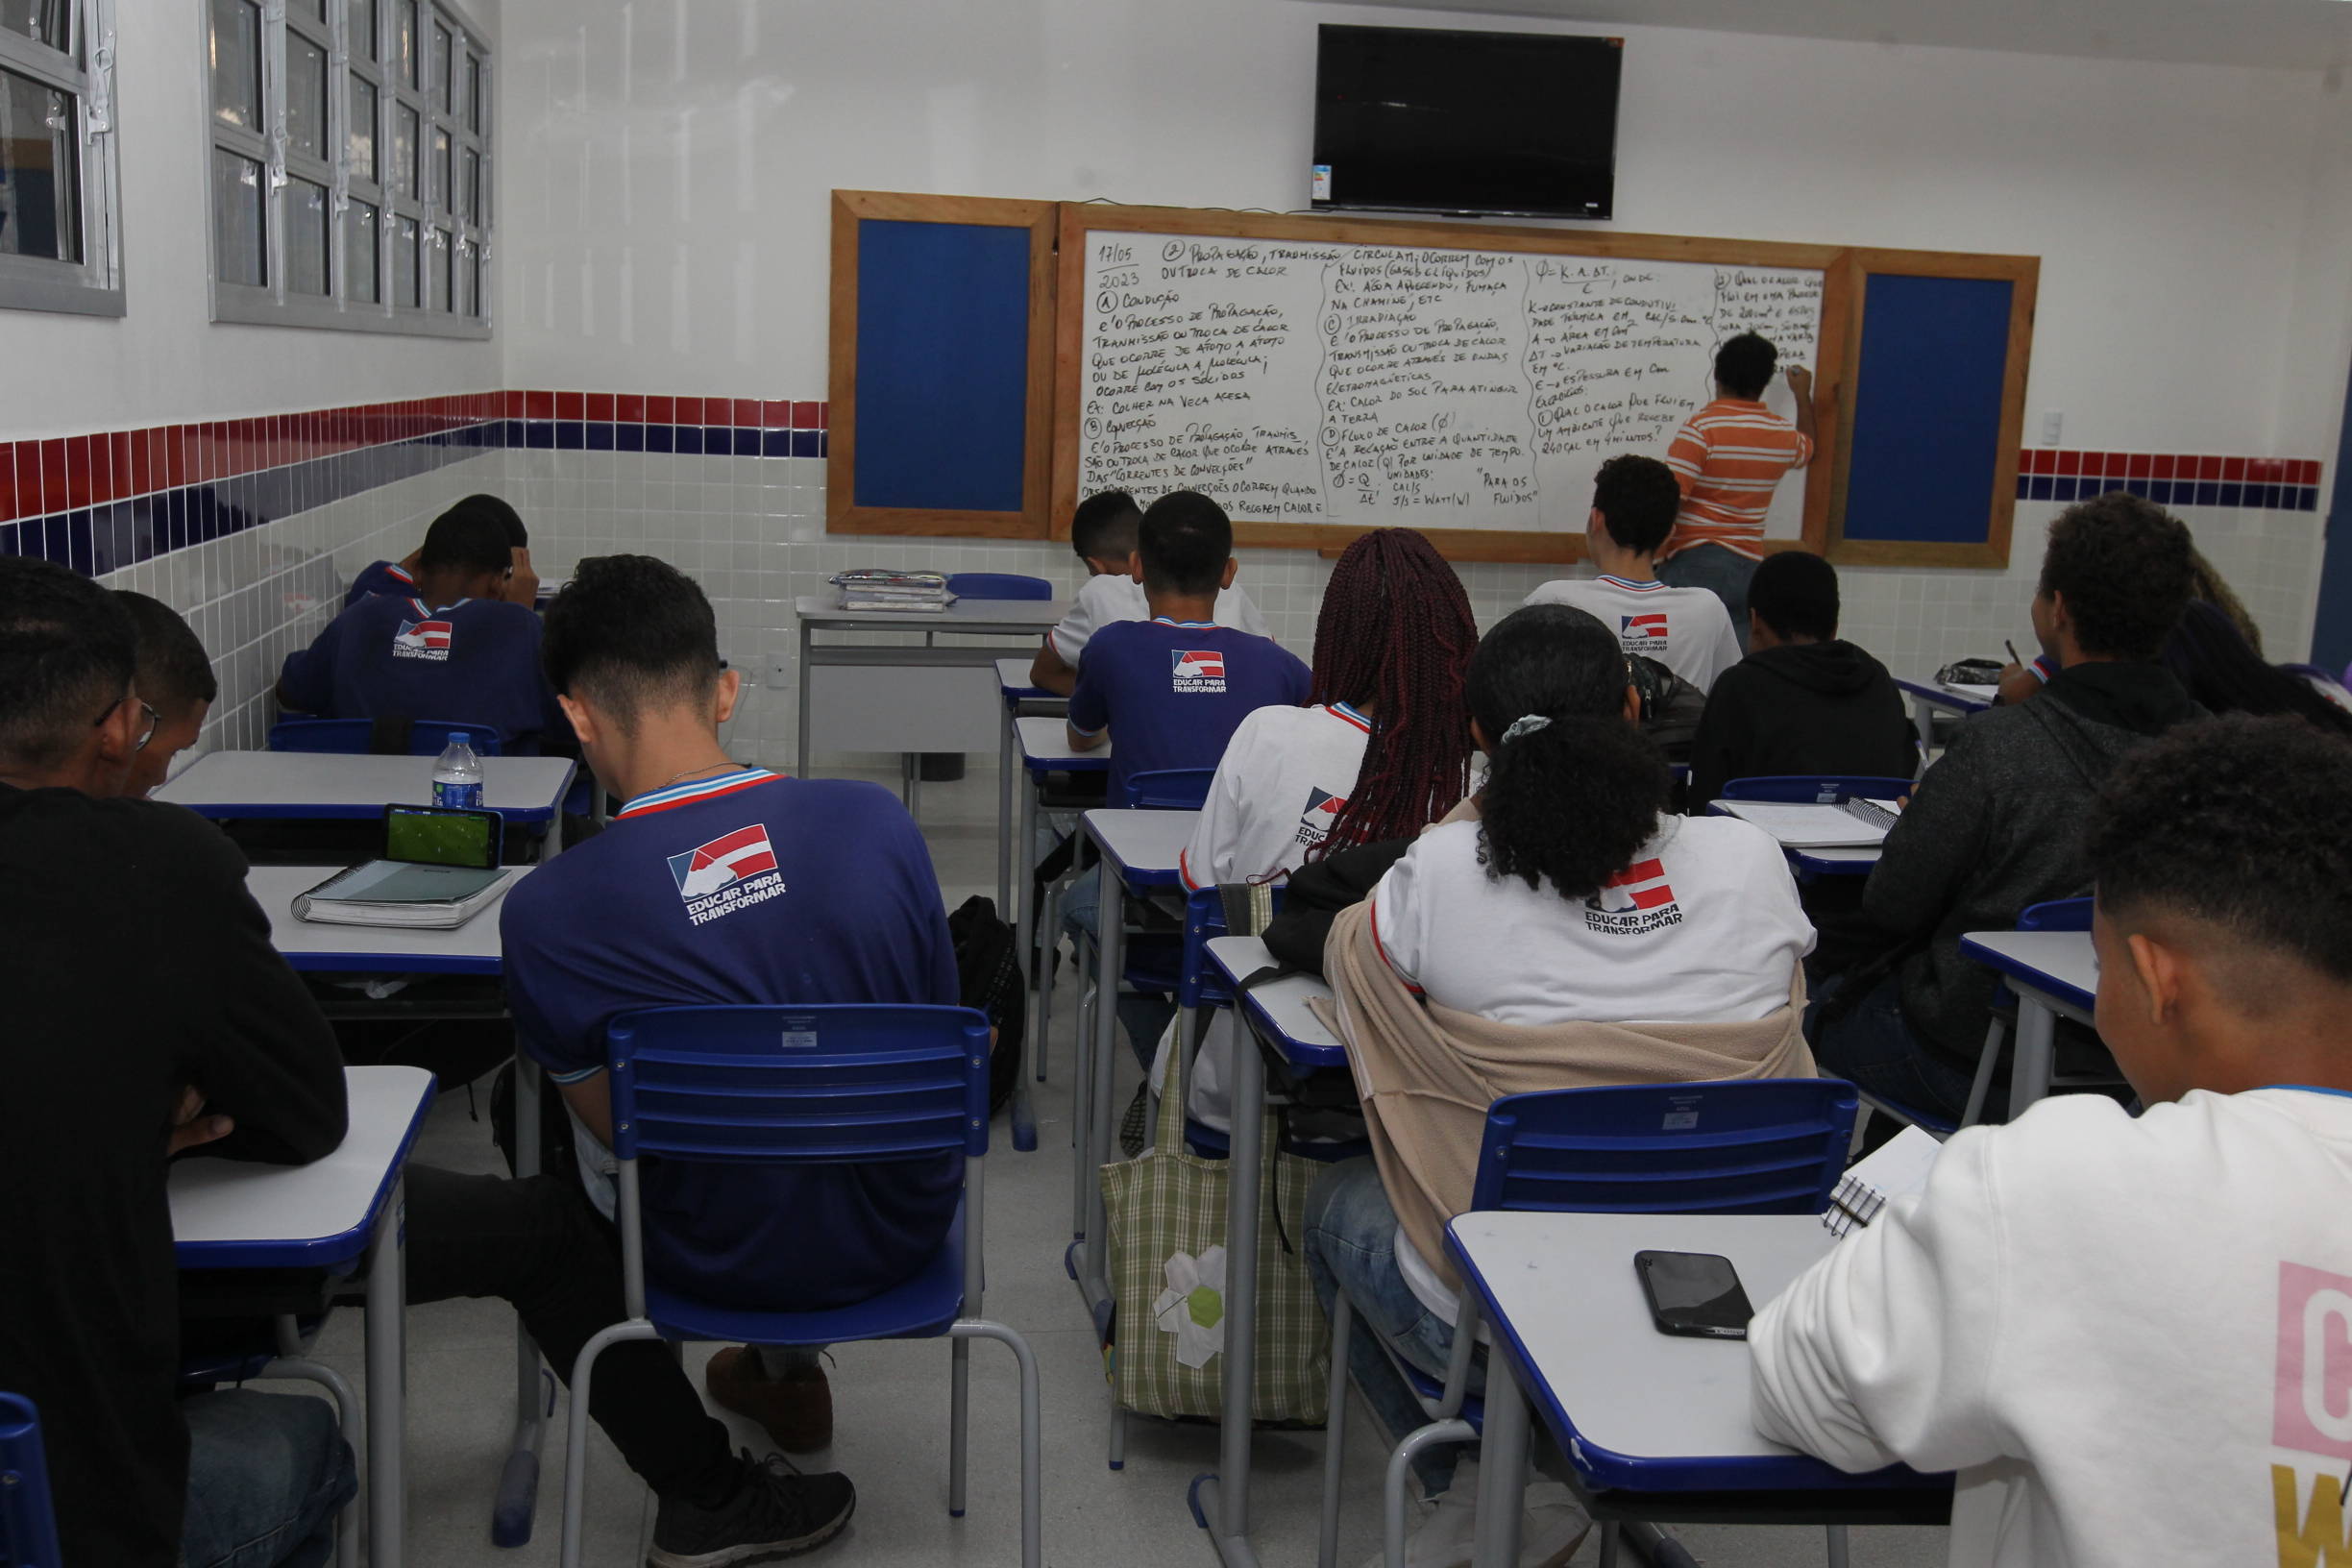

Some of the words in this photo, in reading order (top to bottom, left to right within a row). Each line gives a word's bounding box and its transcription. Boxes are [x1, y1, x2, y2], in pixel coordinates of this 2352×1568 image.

[1098, 243, 1133, 261] 17/05
[1099, 271, 1139, 288] 2023
[1225, 268, 1241, 279] DE
[1332, 299, 1348, 310] NA
[1418, 295, 1442, 306] ETC
[1159, 396, 1174, 407] NA
[686, 887, 743, 916] EDUCAR
[743, 871, 784, 894] PARA
[689, 883, 787, 927] TRANSFORMAR
[1585, 912, 1639, 927] EDUCAR
[1642, 903, 1680, 925] PARA
[1585, 913, 1683, 935] TRANSFORMAR
